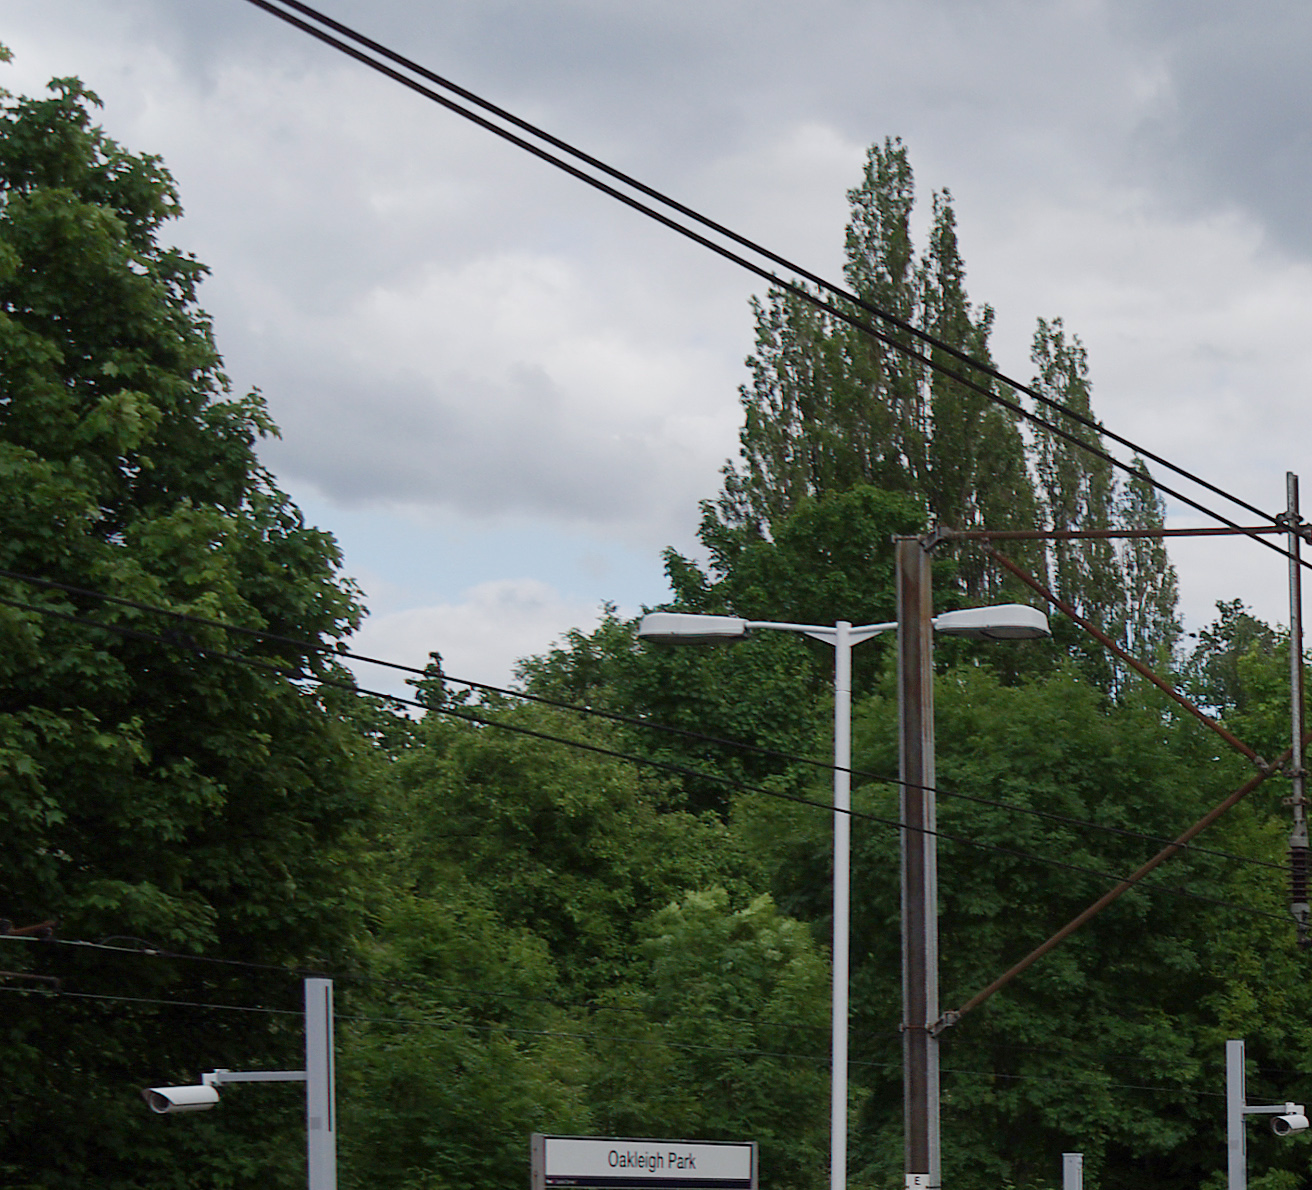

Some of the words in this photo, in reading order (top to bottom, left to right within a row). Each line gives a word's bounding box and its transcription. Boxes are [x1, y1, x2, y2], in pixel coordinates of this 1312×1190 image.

[607, 1149, 664, 1173] Oakleigh
[667, 1151, 697, 1170] Park
[914, 1176, 921, 1185] E
